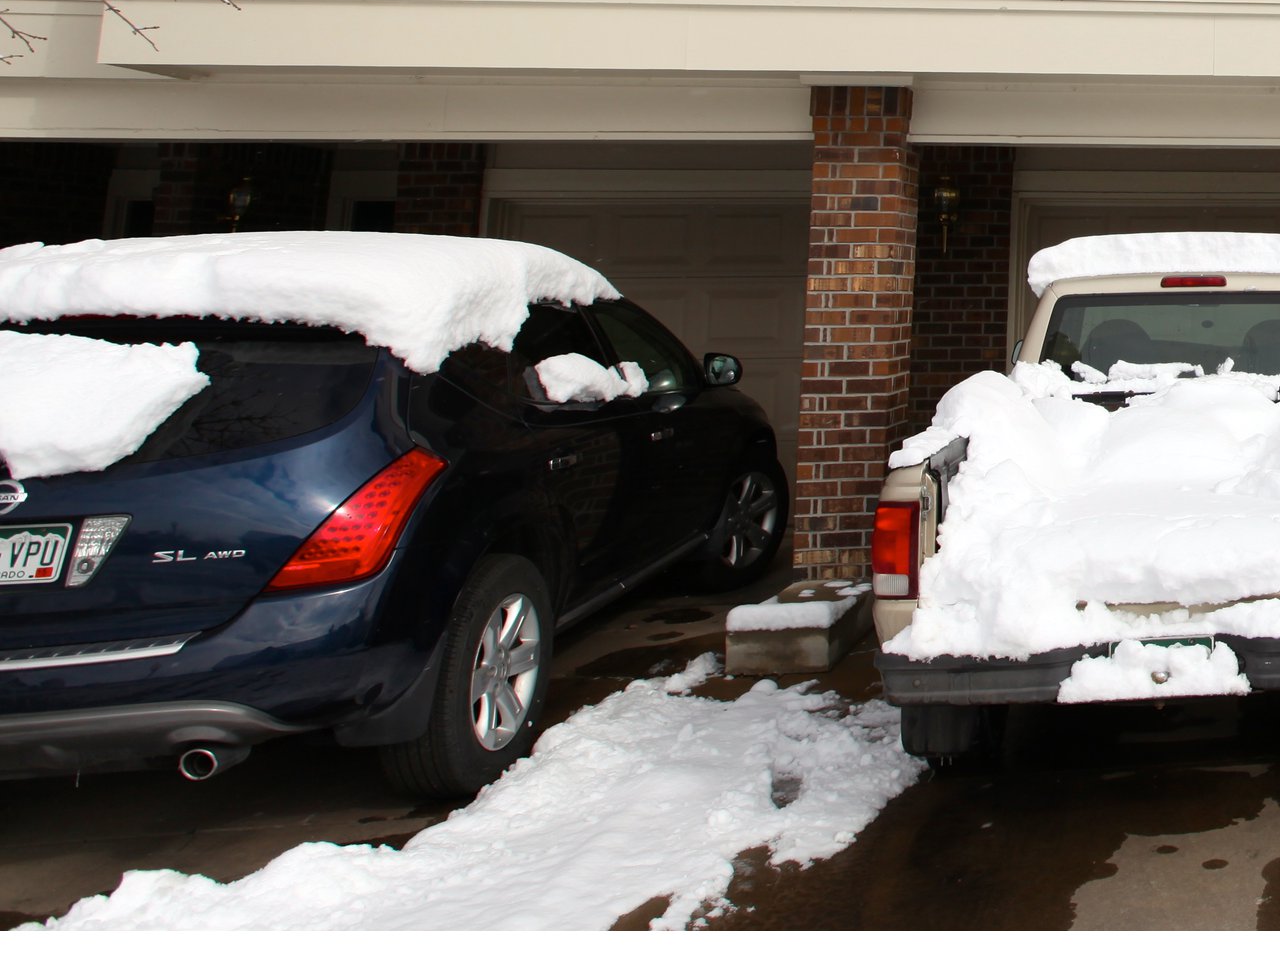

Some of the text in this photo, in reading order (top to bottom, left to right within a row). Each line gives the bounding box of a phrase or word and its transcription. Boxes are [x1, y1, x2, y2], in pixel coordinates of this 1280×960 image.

[10, 540, 60, 568] VPU
[152, 550, 246, 563] SL AWD
[0, 570, 26, 578] ADO
